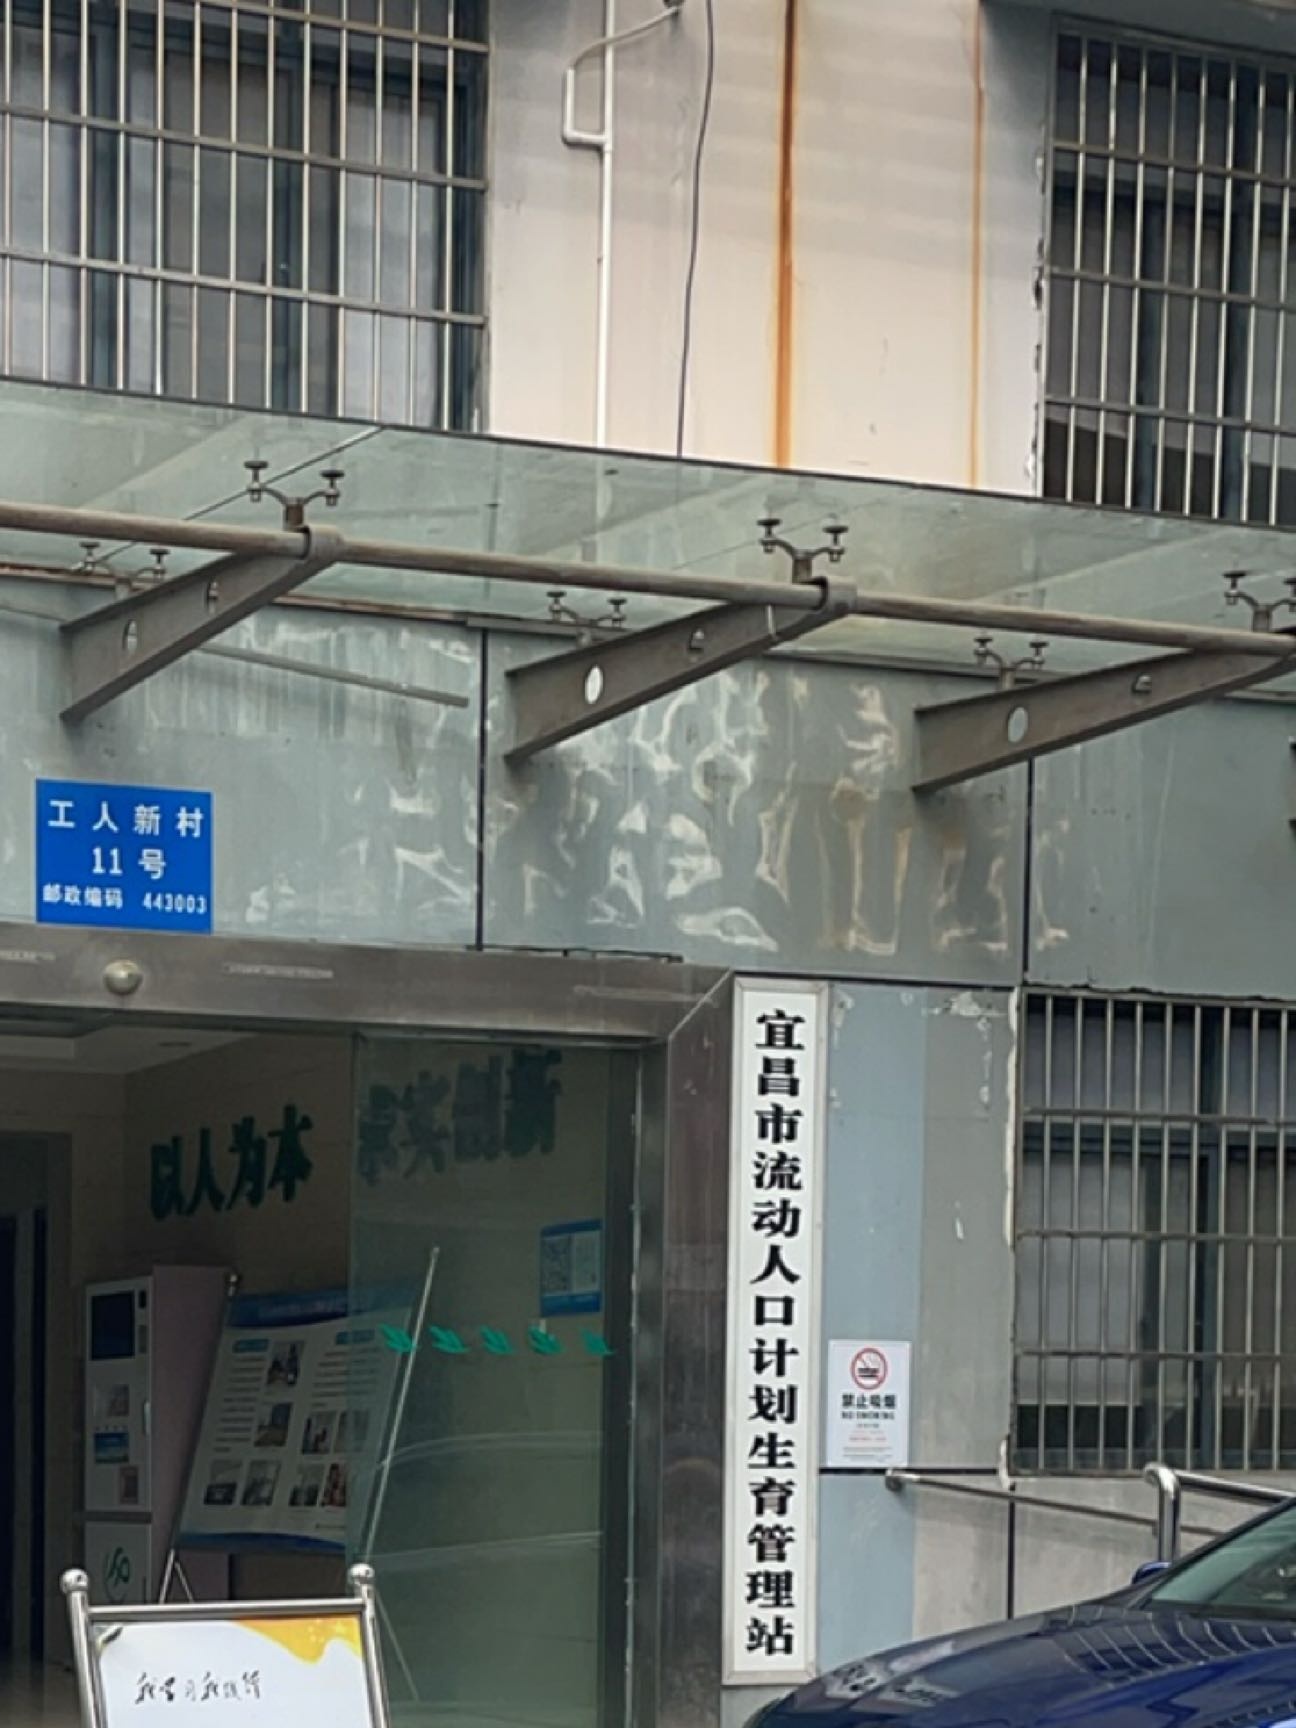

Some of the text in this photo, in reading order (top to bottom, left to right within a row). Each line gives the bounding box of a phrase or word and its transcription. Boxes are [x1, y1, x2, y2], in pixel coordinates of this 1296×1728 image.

[48, 800, 204, 837] 工人新村
[42, 883, 208, 914] 邮政编码 443003
[151, 1104, 313, 1219] 以人为本
[745, 1009, 806, 1656] 宜昌市流动人口计划生育管理站
